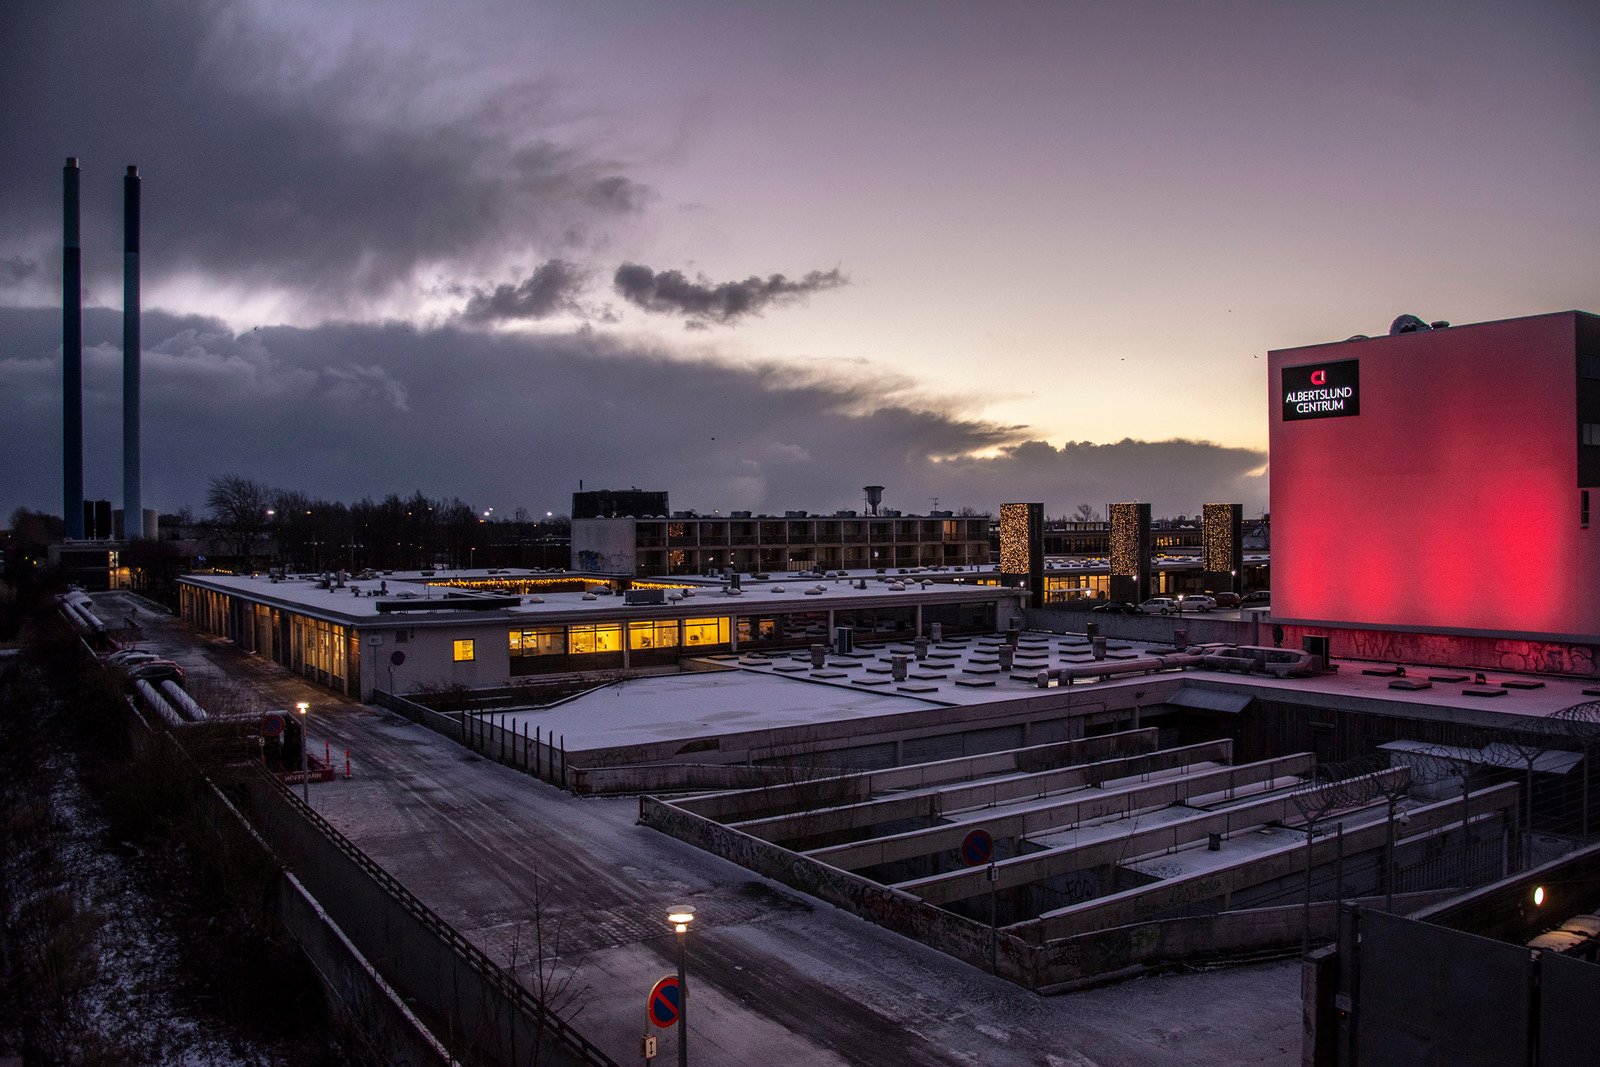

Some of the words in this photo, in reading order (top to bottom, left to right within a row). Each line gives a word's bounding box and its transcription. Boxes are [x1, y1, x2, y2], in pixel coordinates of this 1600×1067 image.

[1286, 387, 1352, 402] ALBERTSLUND
[1296, 400, 1344, 413] CENTRUM
[284, 772, 322, 781] HOFFANN
